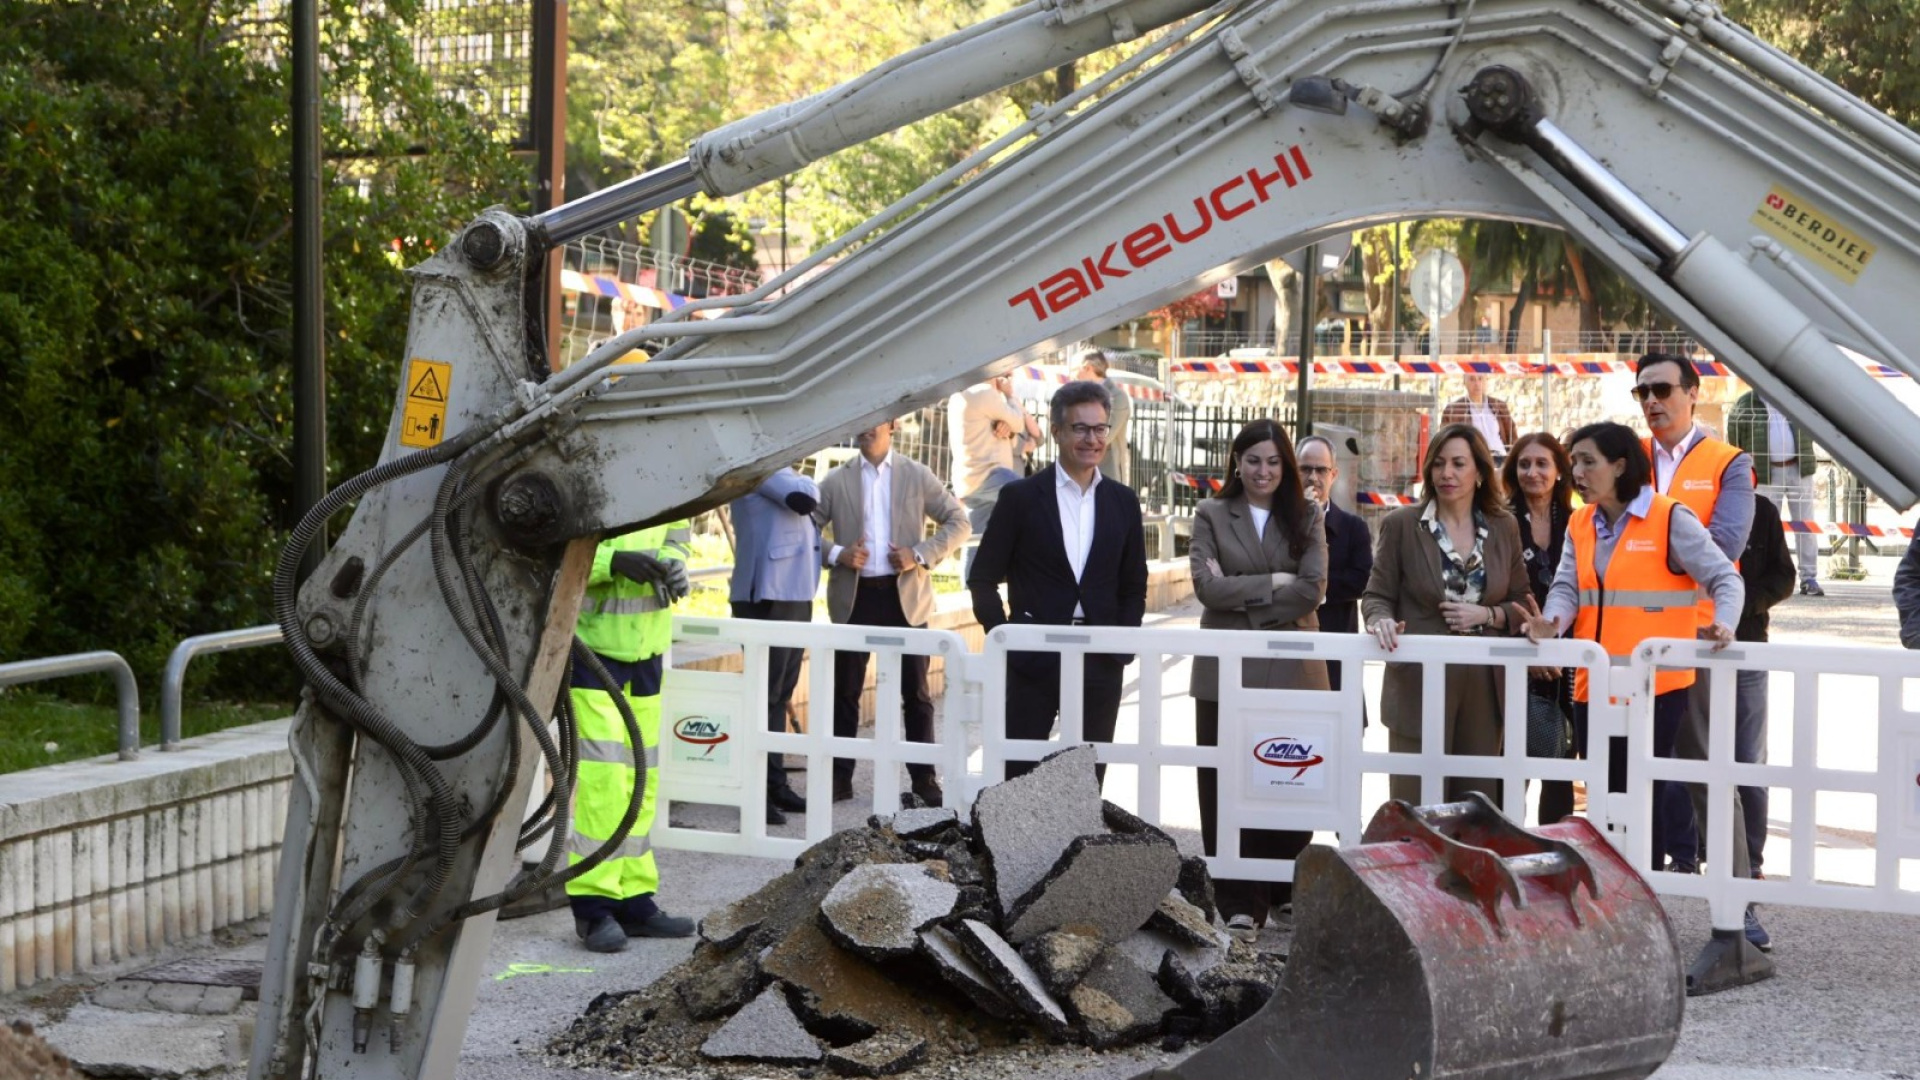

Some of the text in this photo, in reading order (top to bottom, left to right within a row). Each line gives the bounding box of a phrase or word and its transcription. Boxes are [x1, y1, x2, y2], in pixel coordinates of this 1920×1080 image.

[1008, 145, 1313, 321] TAKEUCHI
[1783, 204, 1868, 264] BERDIEL
[683, 720, 720, 733] MIN
[1266, 743, 1313, 756] MIN
